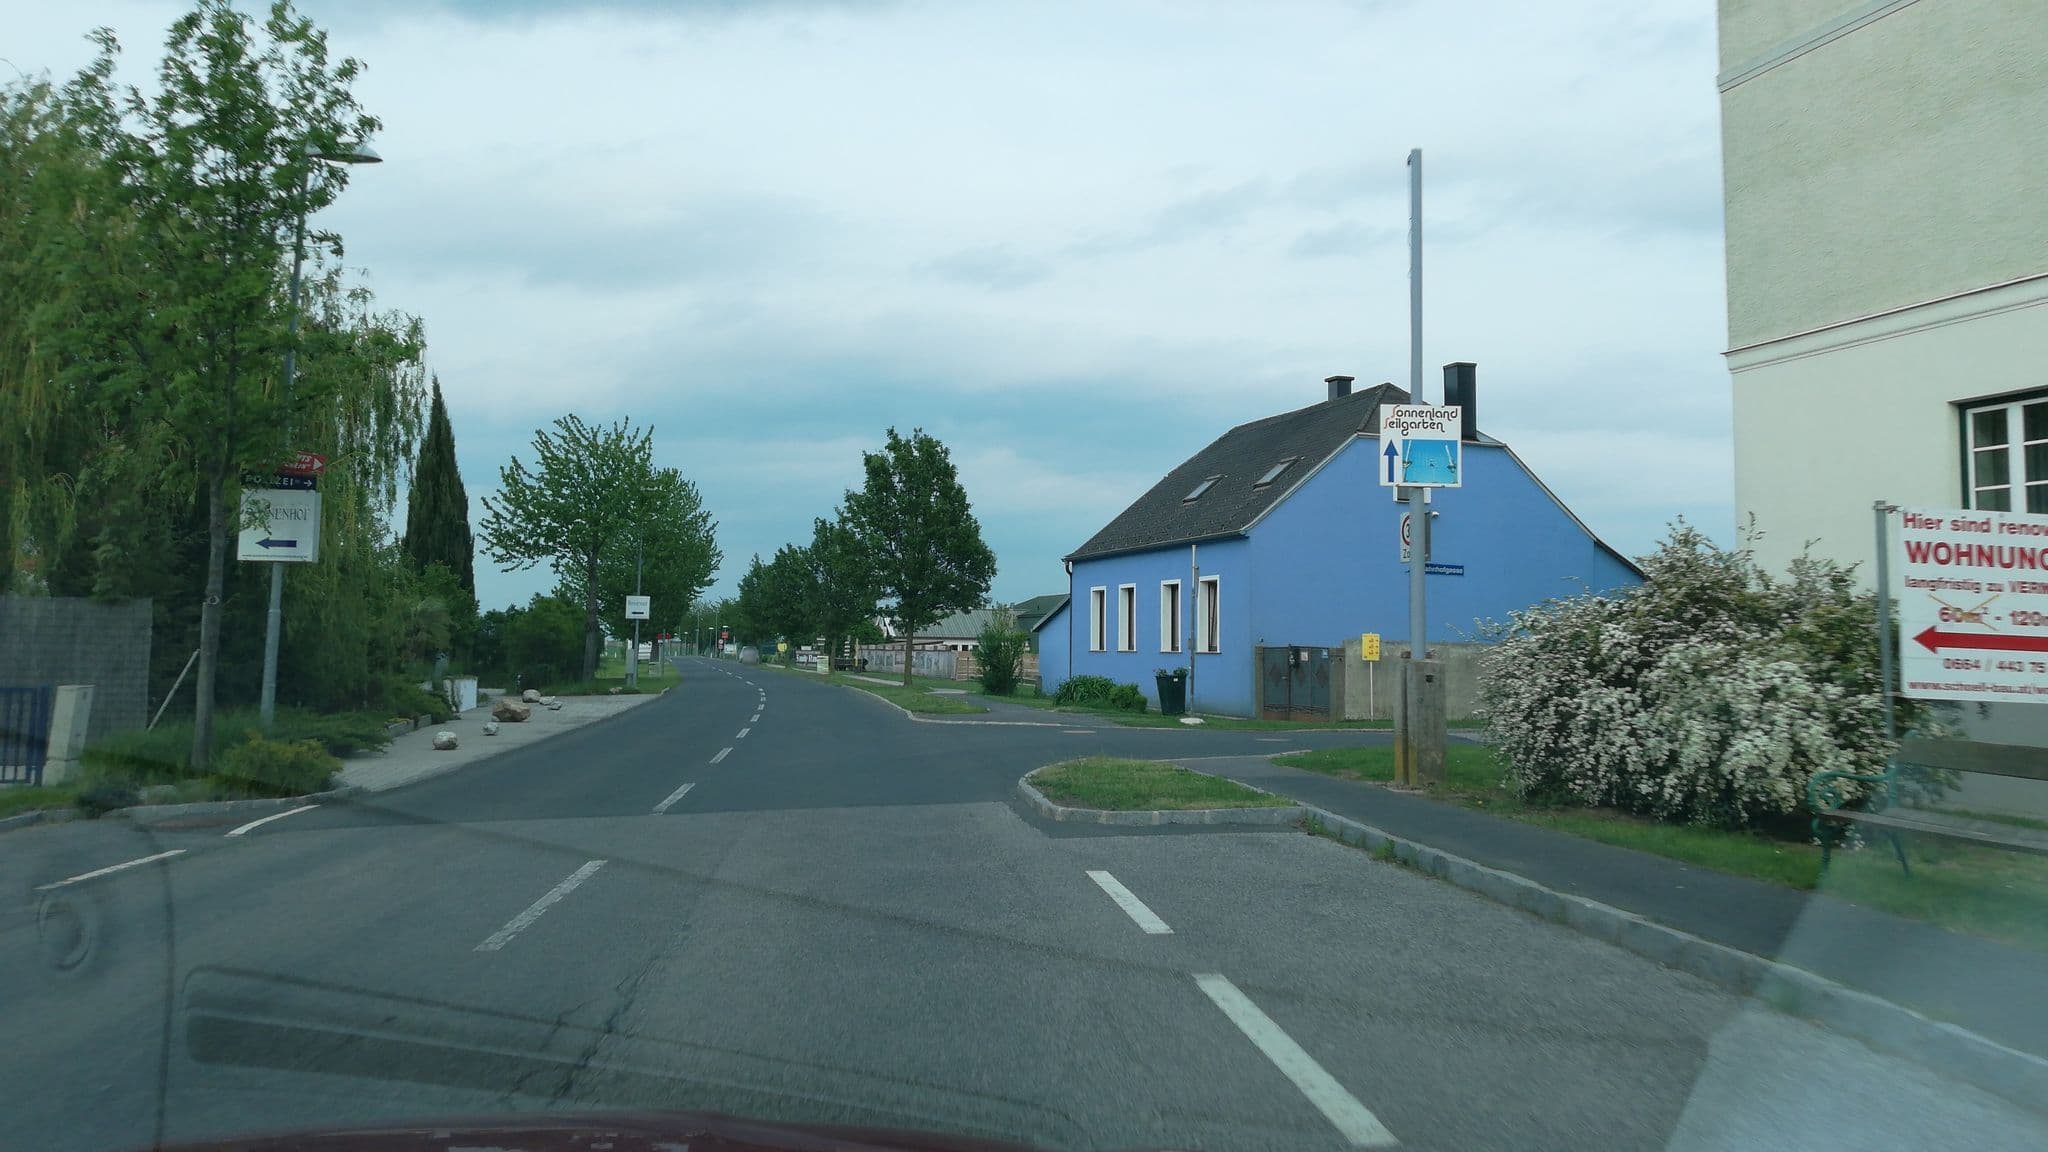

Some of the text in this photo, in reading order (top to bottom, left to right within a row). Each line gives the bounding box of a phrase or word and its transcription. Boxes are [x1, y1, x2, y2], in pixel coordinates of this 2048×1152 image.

[1391, 404, 1458, 421] Sonnenland
[1384, 417, 1445, 436] Seilgarten
[245, 474, 293, 486] POZEI
[1903, 512, 1944, 530] Hier
[1950, 516, 1991, 533] sind
[1425, 566, 1463, 575] ahnhofgasse
[1904, 575, 1981, 593] langfristig
[1986, 582, 2004, 593] zu
[1943, 657, 1981, 671] 0664
[1996, 660, 2024, 673] 443
